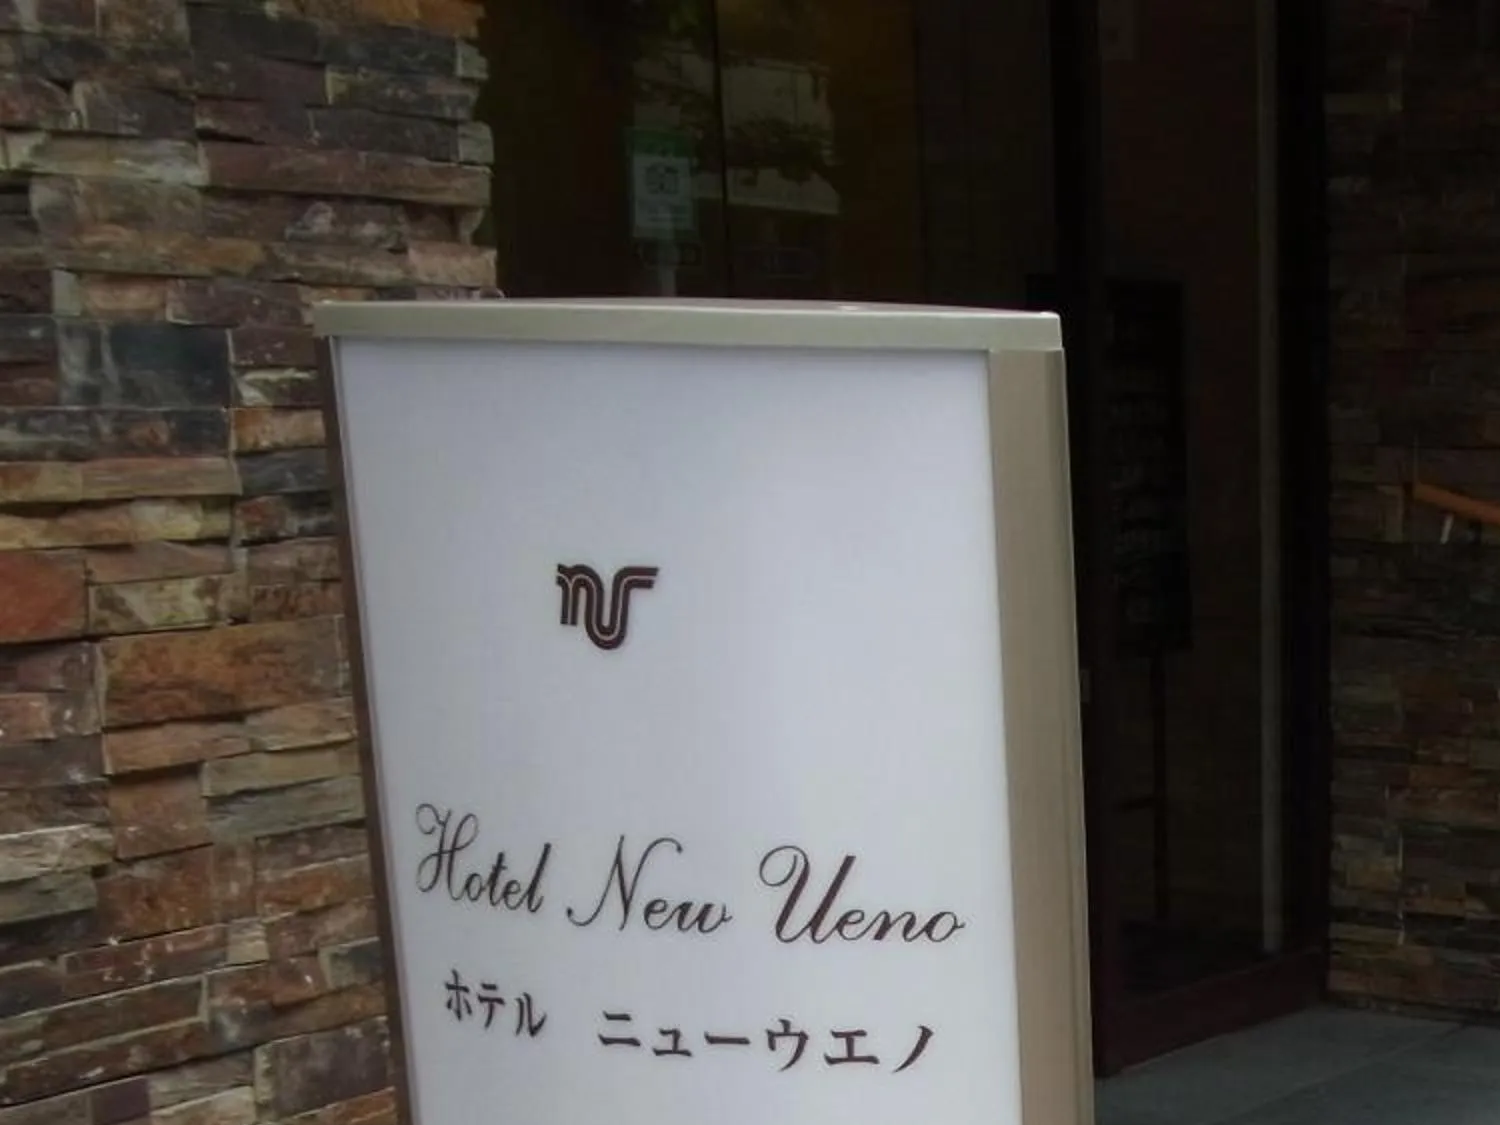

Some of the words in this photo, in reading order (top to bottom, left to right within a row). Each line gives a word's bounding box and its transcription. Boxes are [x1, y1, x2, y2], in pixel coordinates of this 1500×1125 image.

[416, 803, 552, 913] Hotel
[566, 834, 733, 935] New
[759, 845, 965, 944] Ueno
[445, 969, 548, 1038] ホテル
[598, 1010, 935, 1074] ニューウエノ
